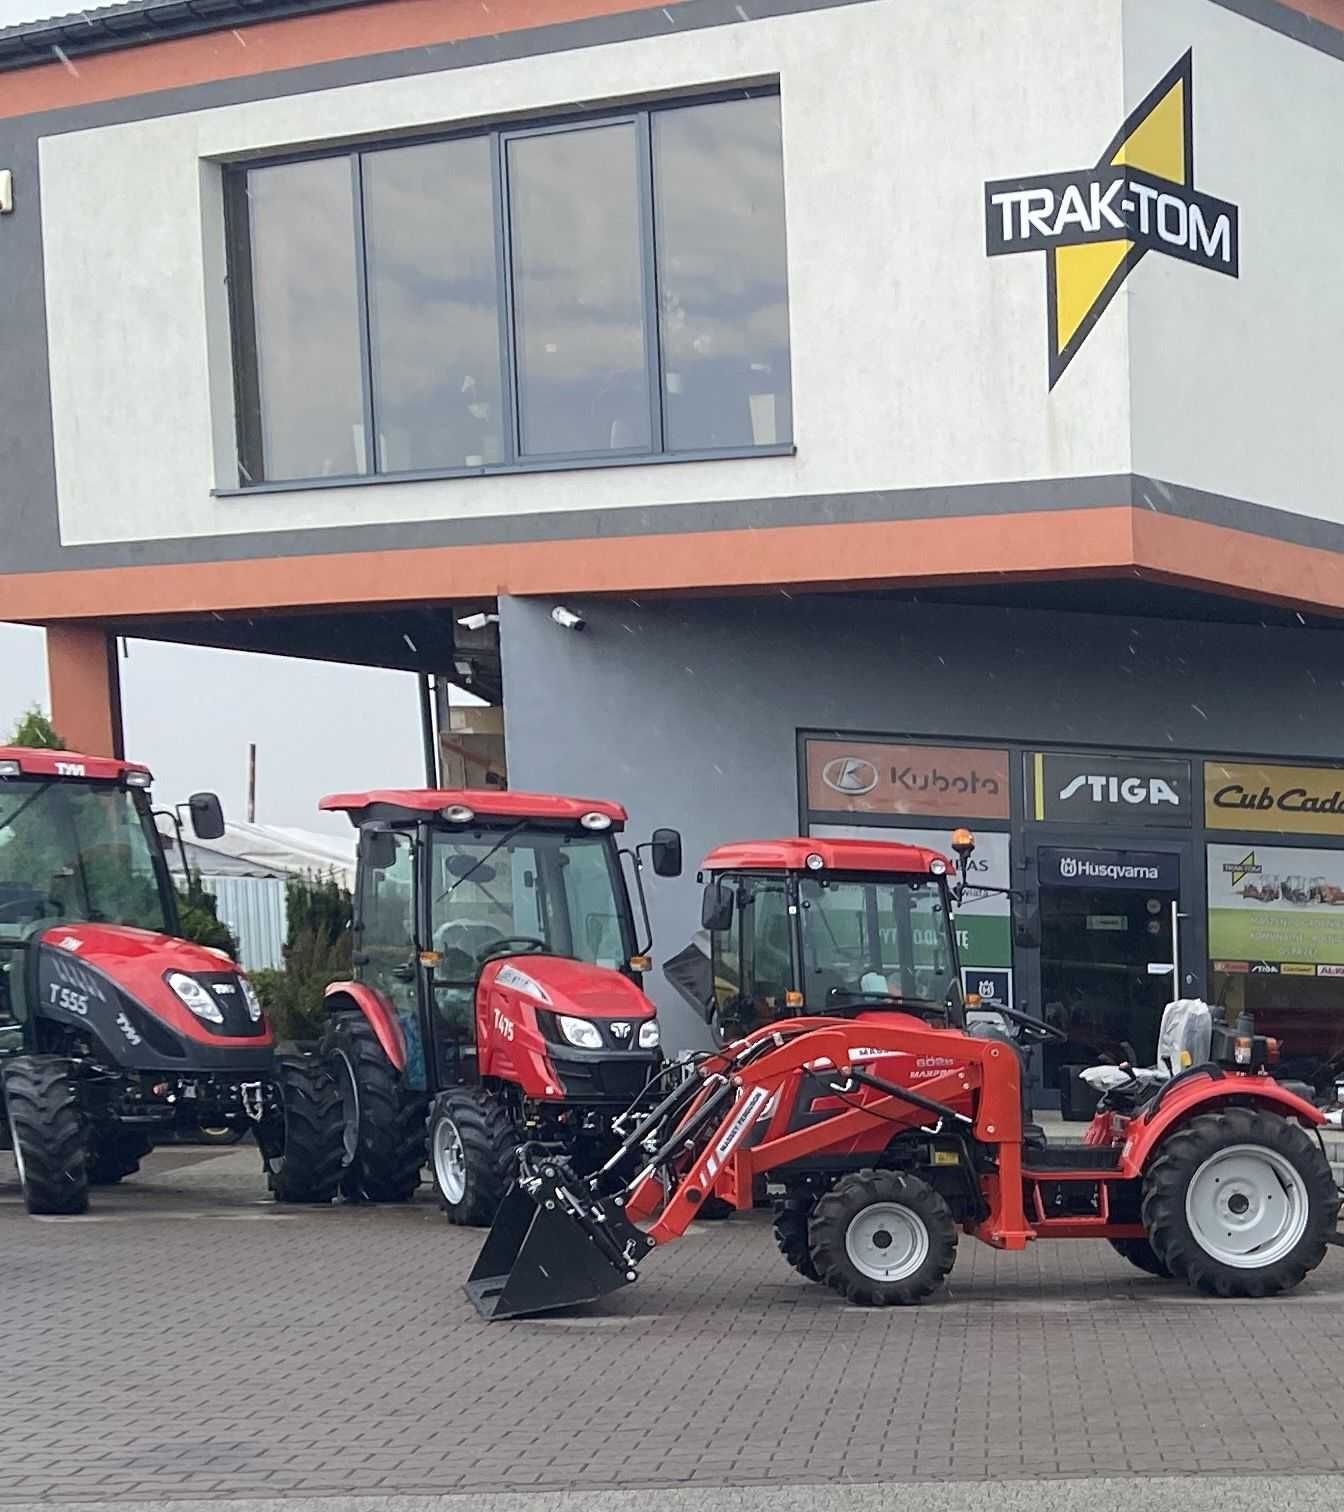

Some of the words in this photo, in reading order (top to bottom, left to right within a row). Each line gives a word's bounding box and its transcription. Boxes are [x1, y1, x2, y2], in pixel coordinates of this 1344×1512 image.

[991, 178, 1231, 262] TRAK-TOM
[890, 766, 999, 795] Kubota
[1059, 775, 1179, 805] STIGA
[1213, 785, 1274, 810] Cub
[1078, 861, 1159, 879] Husqvarna
